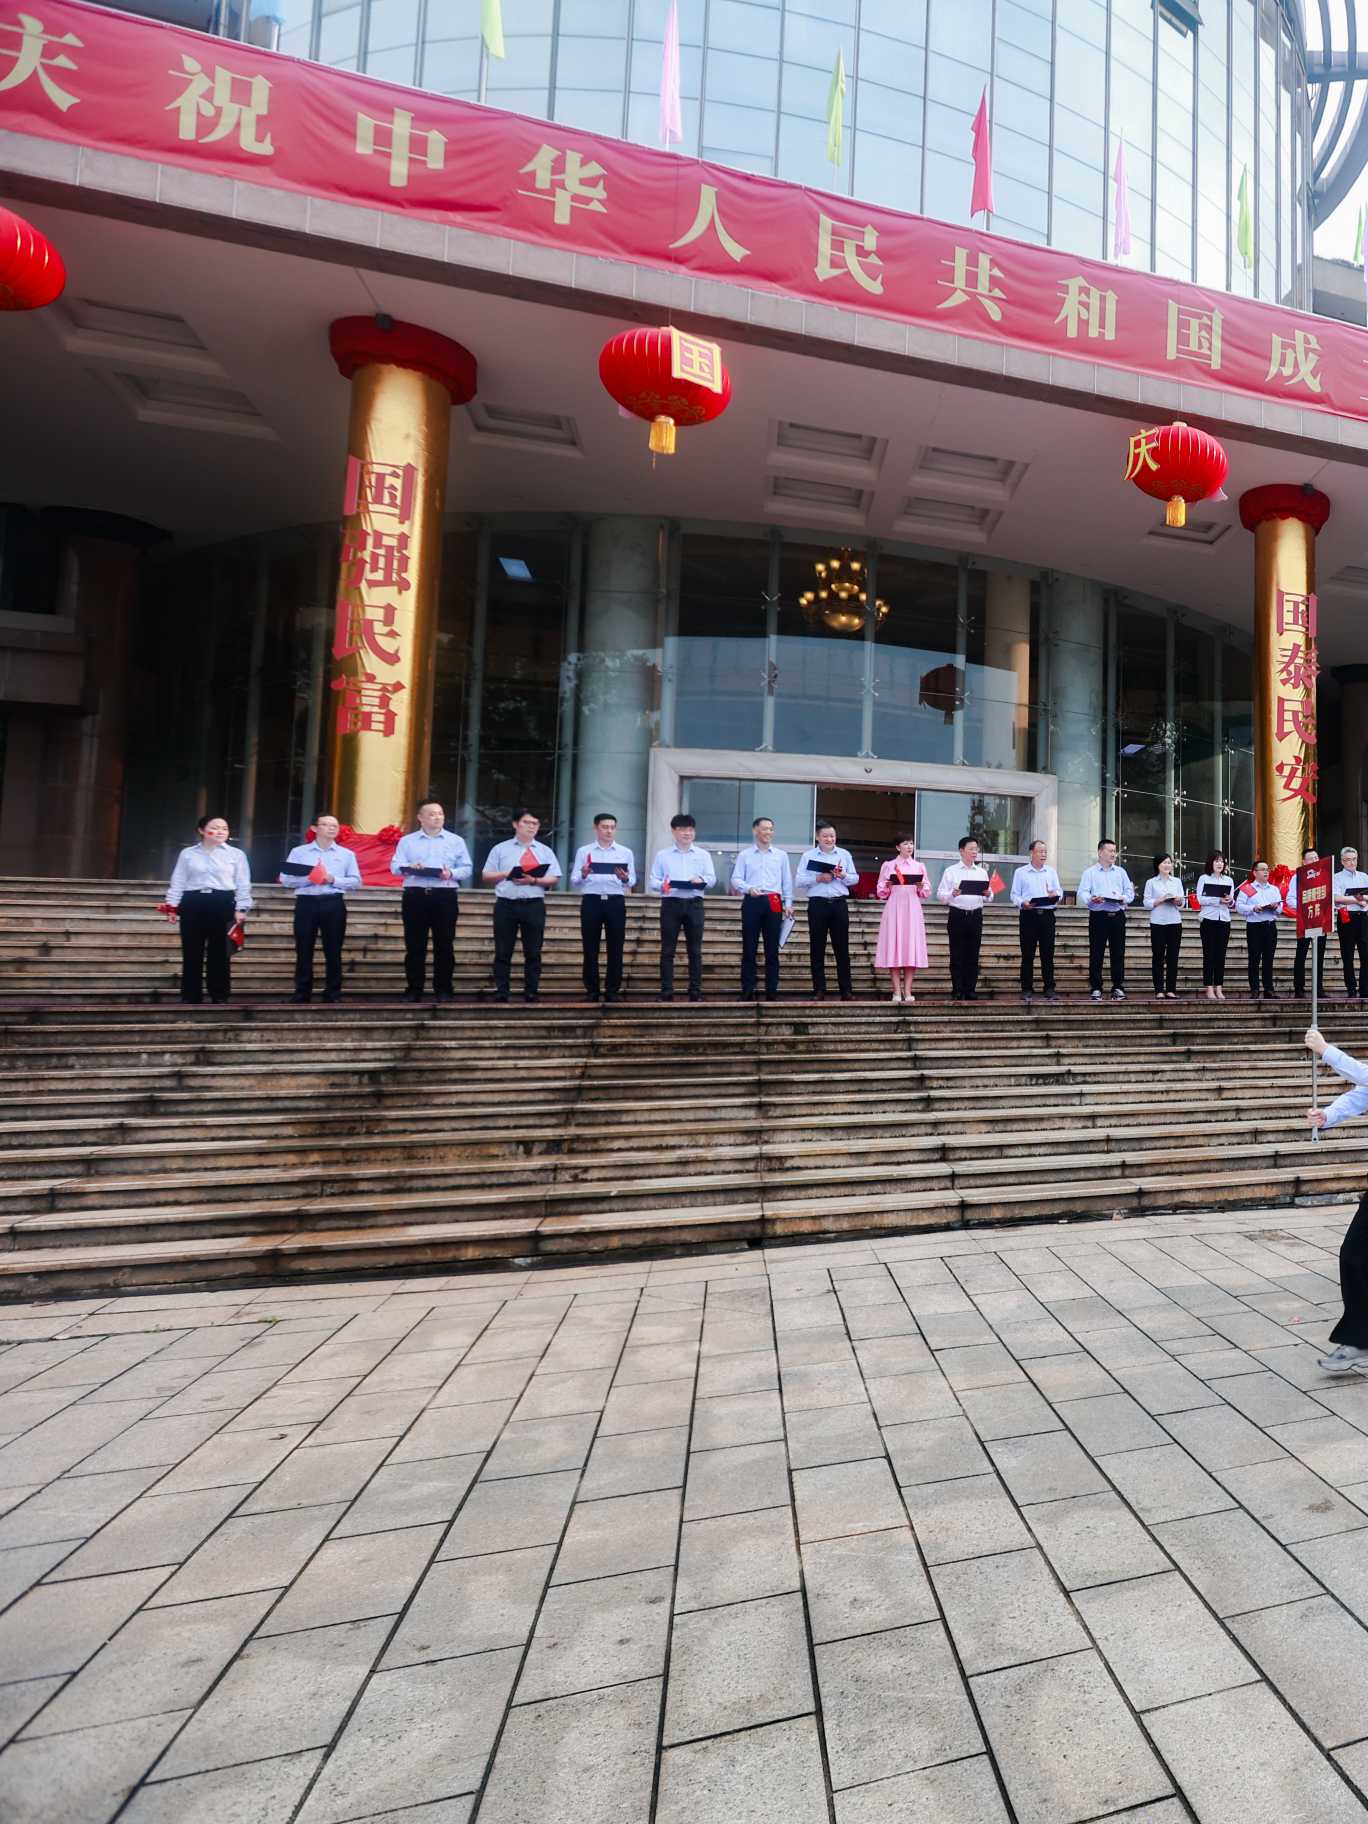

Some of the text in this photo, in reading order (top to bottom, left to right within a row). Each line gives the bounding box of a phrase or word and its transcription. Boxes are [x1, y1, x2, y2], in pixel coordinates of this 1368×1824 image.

[671, 326, 722, 394] 国
[1124, 427, 1160, 480] 庆
[331, 454, 418, 738] 国强民富
[1275, 588, 1320, 805] 国泰民安
